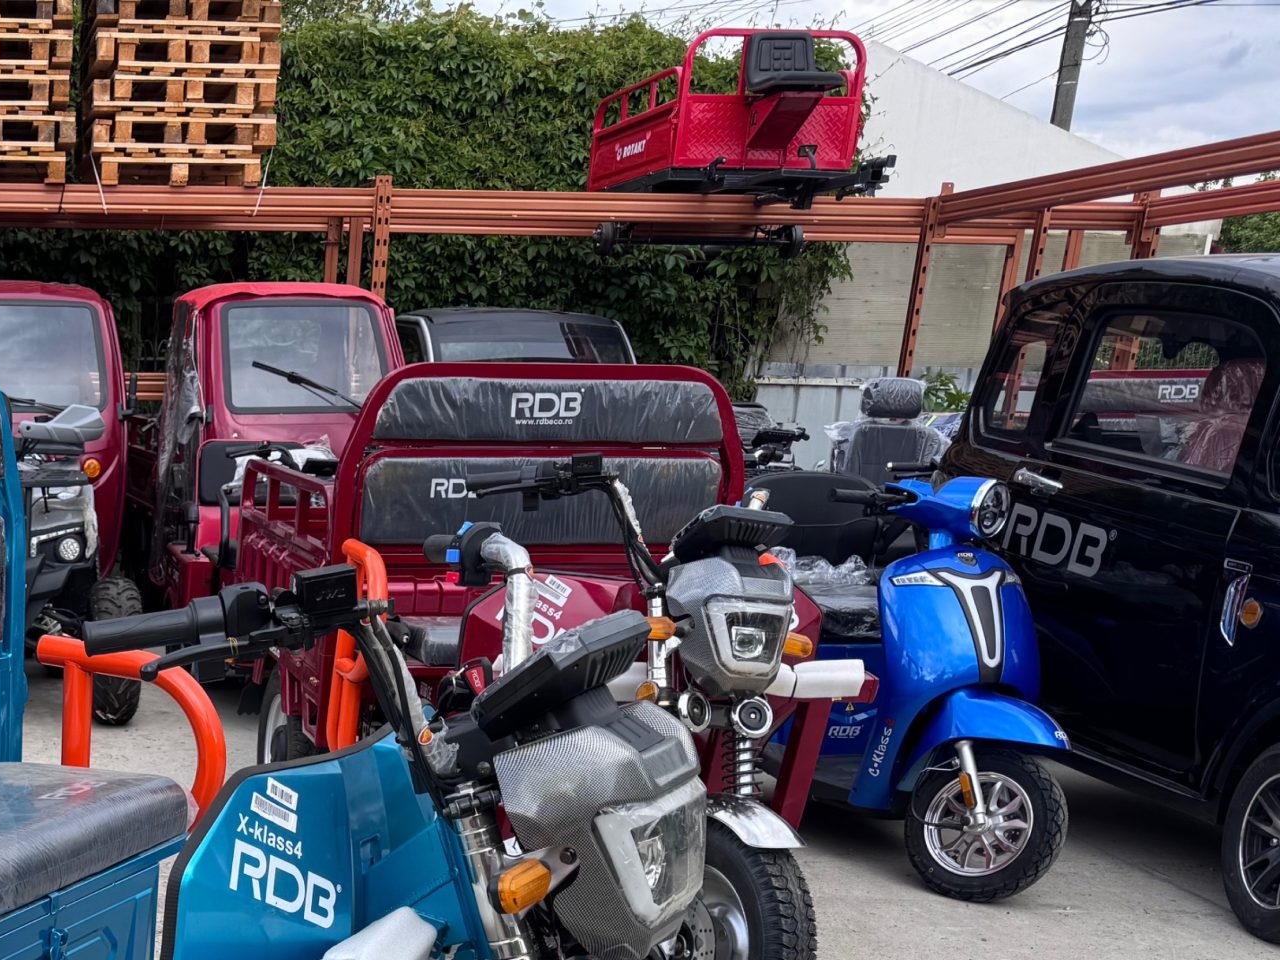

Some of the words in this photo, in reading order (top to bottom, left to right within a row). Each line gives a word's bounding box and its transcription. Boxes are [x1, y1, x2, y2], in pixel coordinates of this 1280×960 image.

[1158, 384, 1199, 399] RDB
[510, 392, 582, 417] RDB
[430, 478, 477, 498] RD
[1002, 502, 1108, 577] RDB
[828, 726, 861, 737] RDB
[237, 813, 303, 859] X-klass4
[229, 838, 337, 929] RDB
